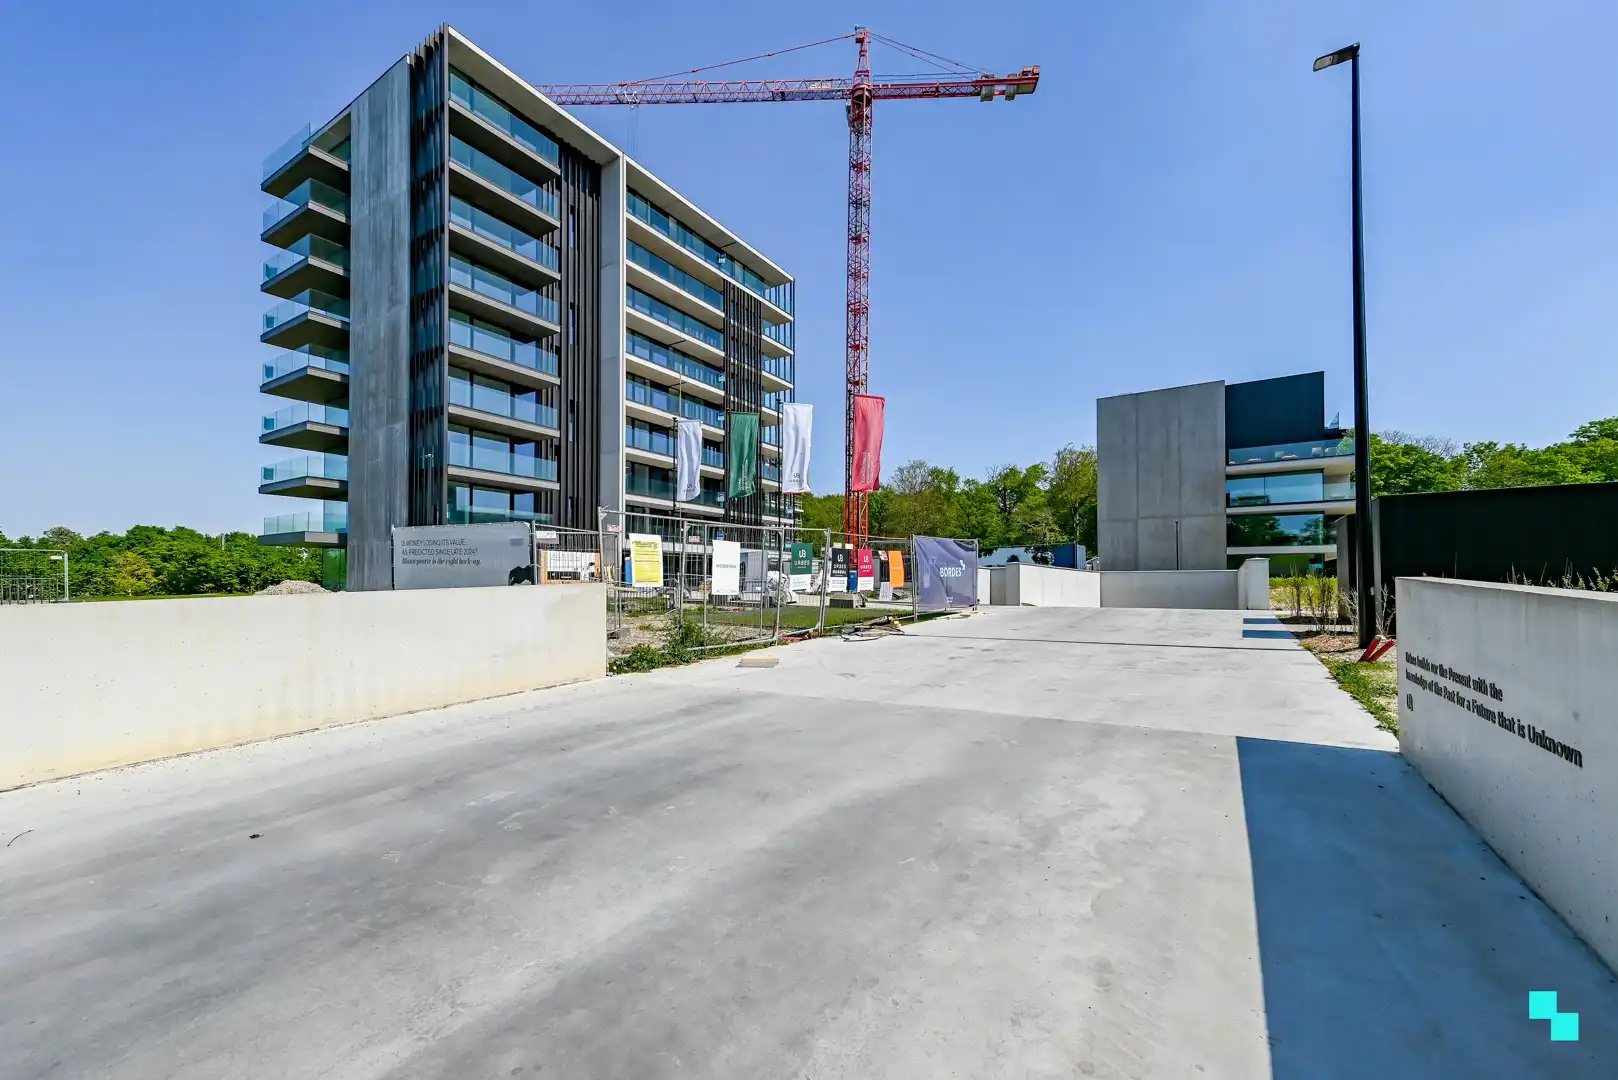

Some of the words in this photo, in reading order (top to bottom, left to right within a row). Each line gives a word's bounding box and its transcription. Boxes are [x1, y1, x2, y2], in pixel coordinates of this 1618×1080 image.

[408, 548, 434, 556] PREDICTED
[940, 567, 961, 578] BORDES
[1439, 664, 1448, 679] the
[1449, 667, 1471, 689] Present
[1472, 677, 1488, 696] with
[1489, 683, 1503, 702] the
[1428, 680, 1433, 692] of
[1434, 681, 1442, 697] the
[1443, 686, 1455, 704] Past
[1456, 691, 1465, 709] for
[1466, 699, 1471, 712] a
[1472, 699, 1496, 724] Future
[1497, 711, 1516, 734] that
[1517, 719, 1526, 739] is
[1528, 724, 1583, 768] Unknown
